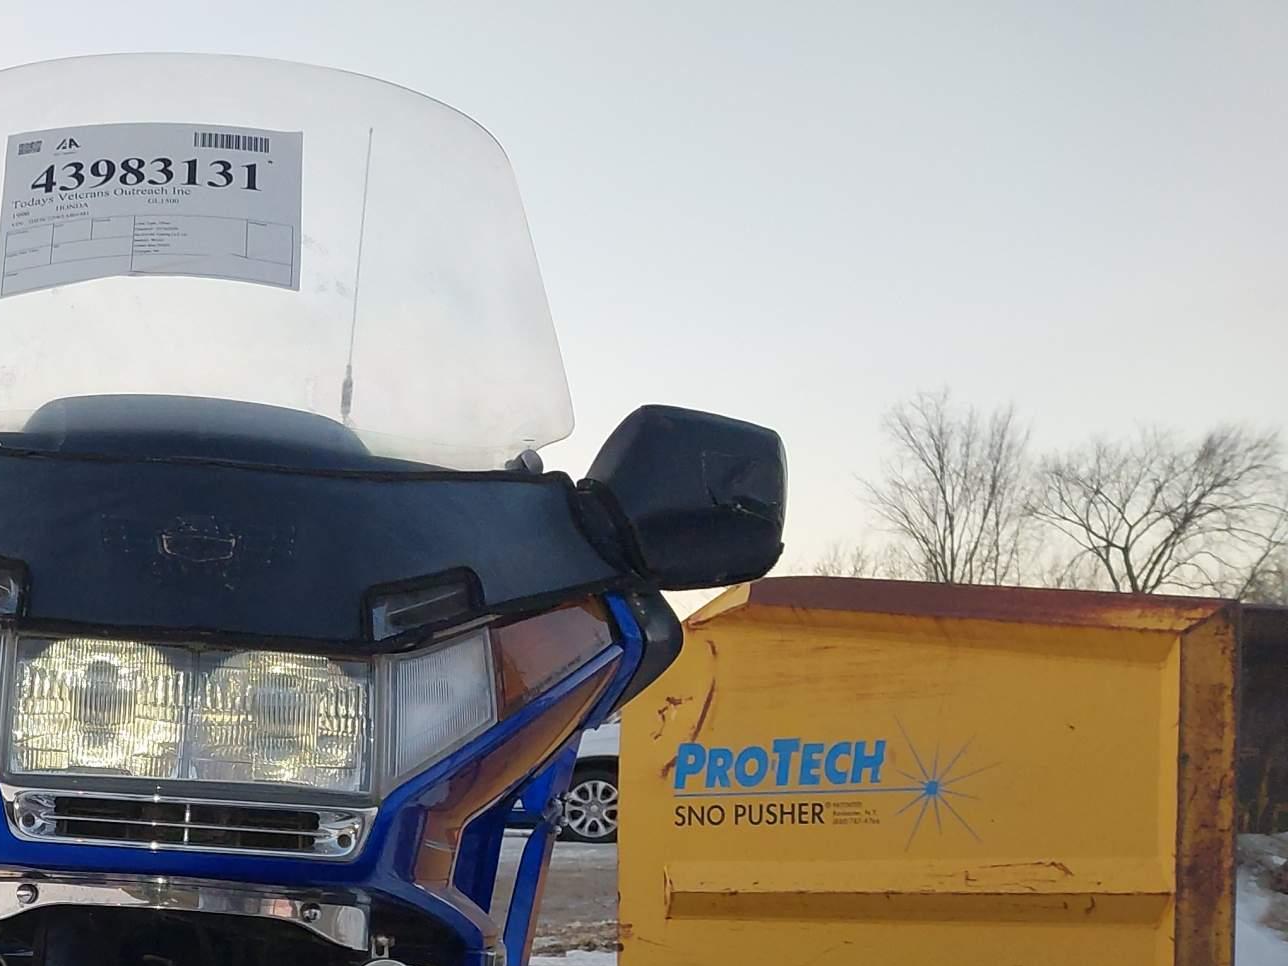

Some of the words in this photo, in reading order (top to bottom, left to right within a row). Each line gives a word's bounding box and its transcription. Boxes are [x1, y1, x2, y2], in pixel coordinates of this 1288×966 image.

[31, 157, 262, 194] 43983131
[13, 197, 55, 209] Todays
[58, 190, 110, 201] Veterans
[113, 186, 168, 196] Outreach
[172, 186, 191, 195] Inc
[674, 804, 725, 826] SNO
[734, 802, 825, 825] PUSHER
